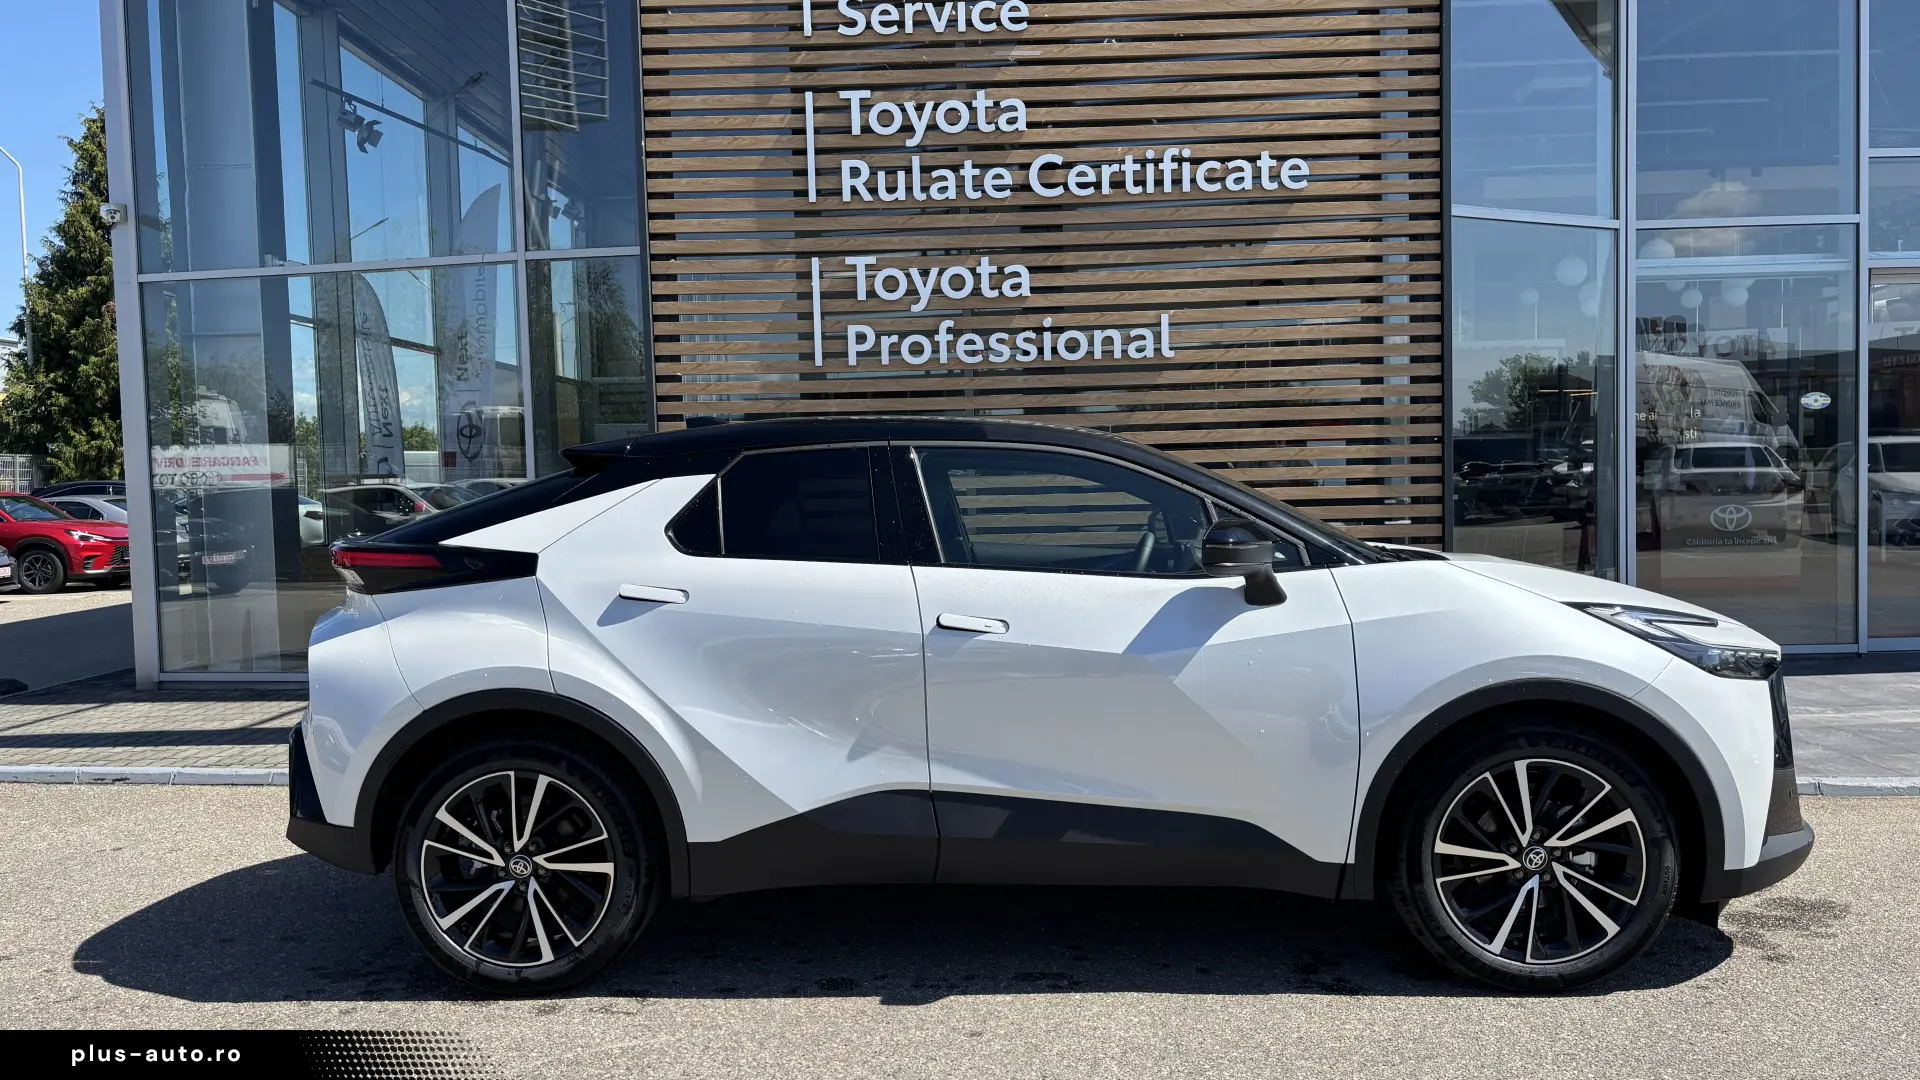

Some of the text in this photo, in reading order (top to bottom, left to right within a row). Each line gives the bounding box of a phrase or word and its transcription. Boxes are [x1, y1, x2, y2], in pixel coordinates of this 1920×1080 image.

[838, 0, 1030, 36] Service
[838, 89, 1028, 147] Toyota
[841, 147, 1311, 203] Rulate Certificate
[844, 256, 1032, 312] Toyota
[457, 331, 469, 382] Next
[847, 313, 1176, 366] Professional
[1661, 865, 1672, 896] OUTSIDE
